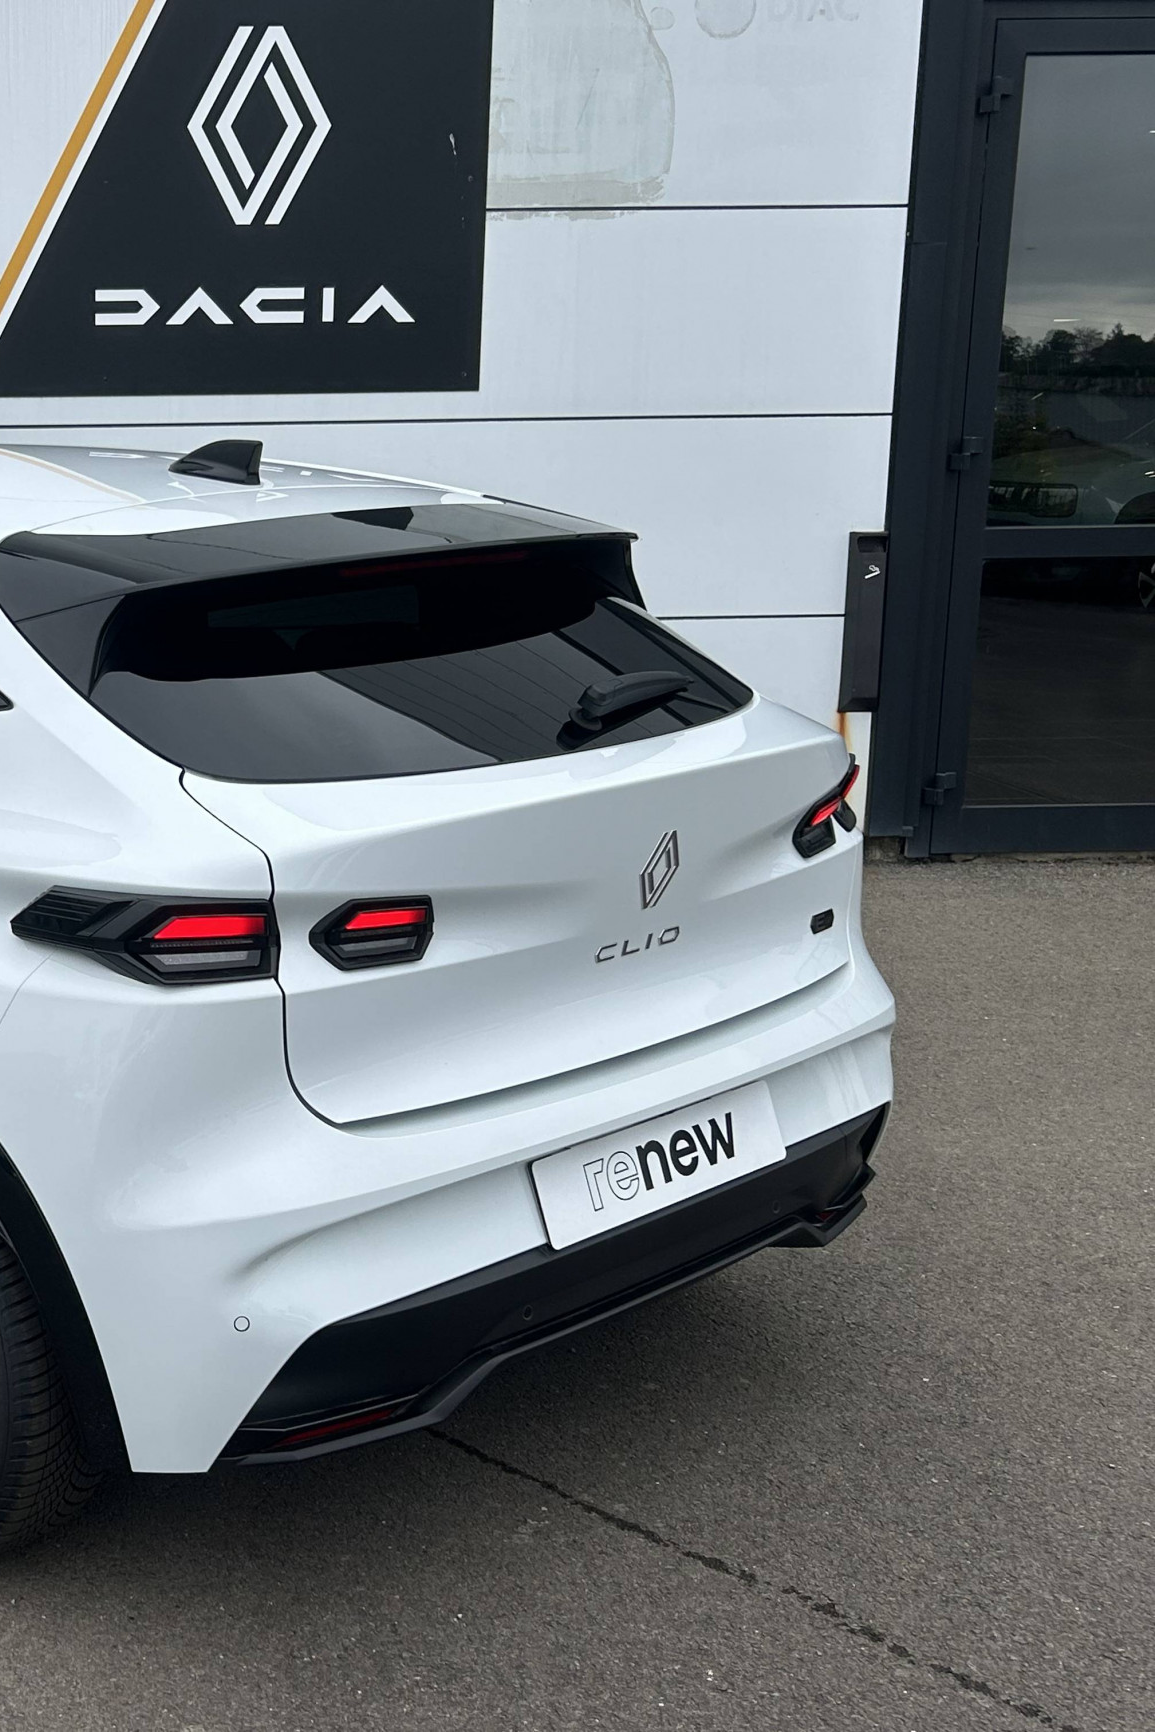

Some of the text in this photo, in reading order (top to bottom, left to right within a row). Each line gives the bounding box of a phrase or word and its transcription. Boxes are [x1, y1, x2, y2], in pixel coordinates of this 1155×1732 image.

[94, 284, 416, 326] DACIA
[595, 926, 680, 963] CLIO
[583, 1111, 735, 1212] renew
